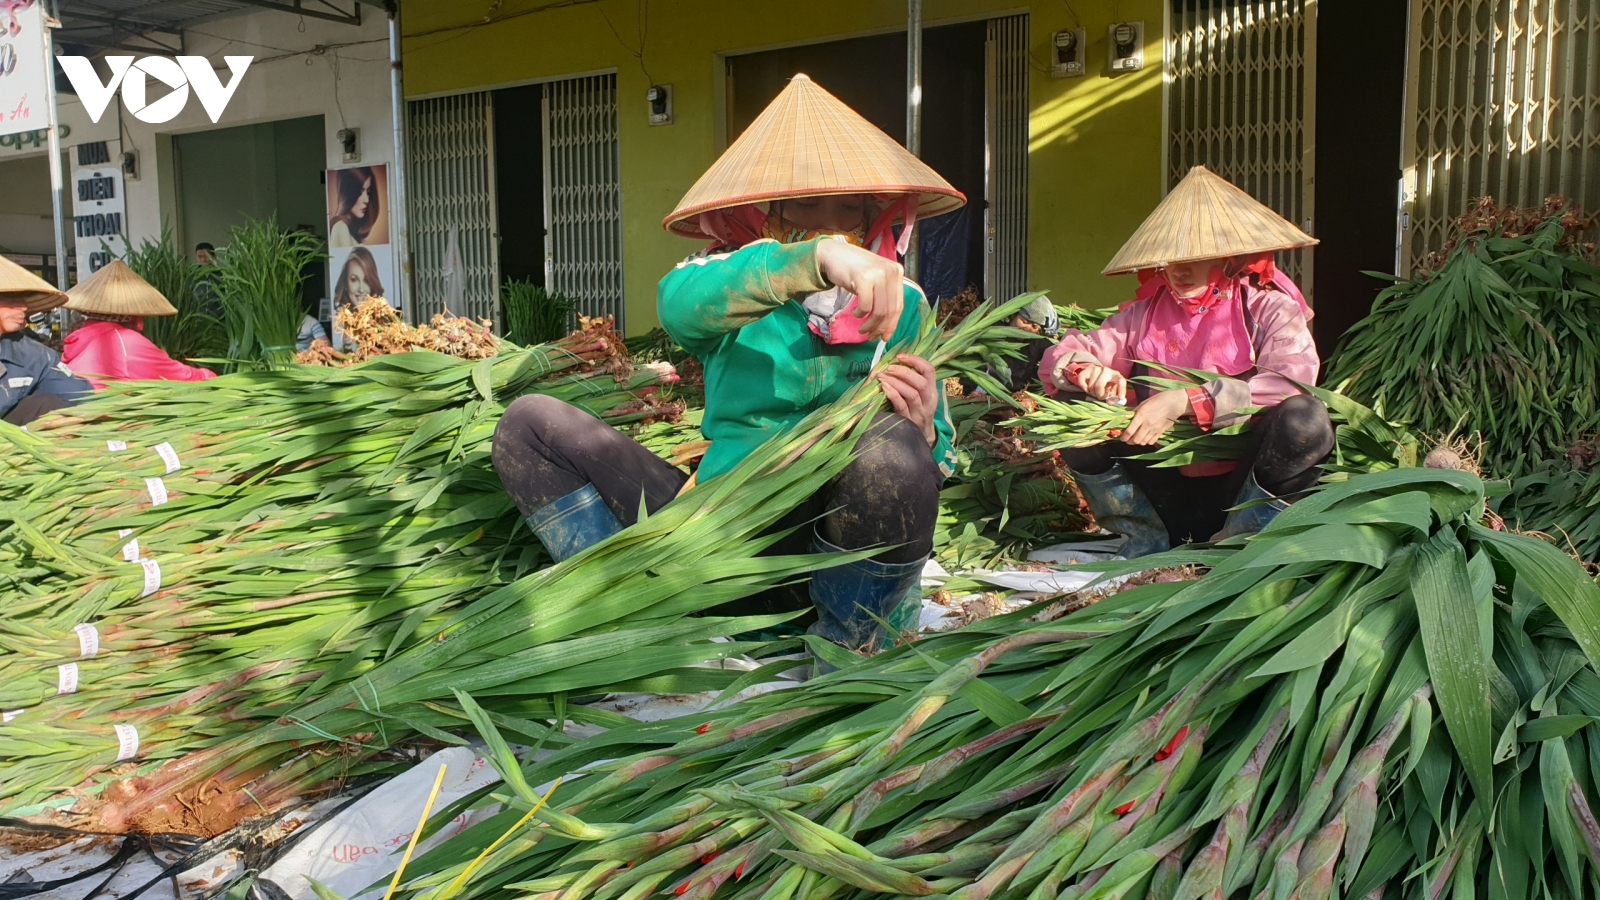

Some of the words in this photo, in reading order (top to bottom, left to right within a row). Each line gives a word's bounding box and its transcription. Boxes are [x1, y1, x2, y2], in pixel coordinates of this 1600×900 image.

[77, 141, 110, 166] MUA
[78, 172, 115, 206] ĐIỆN
[74, 212, 121, 241] THOẠI
